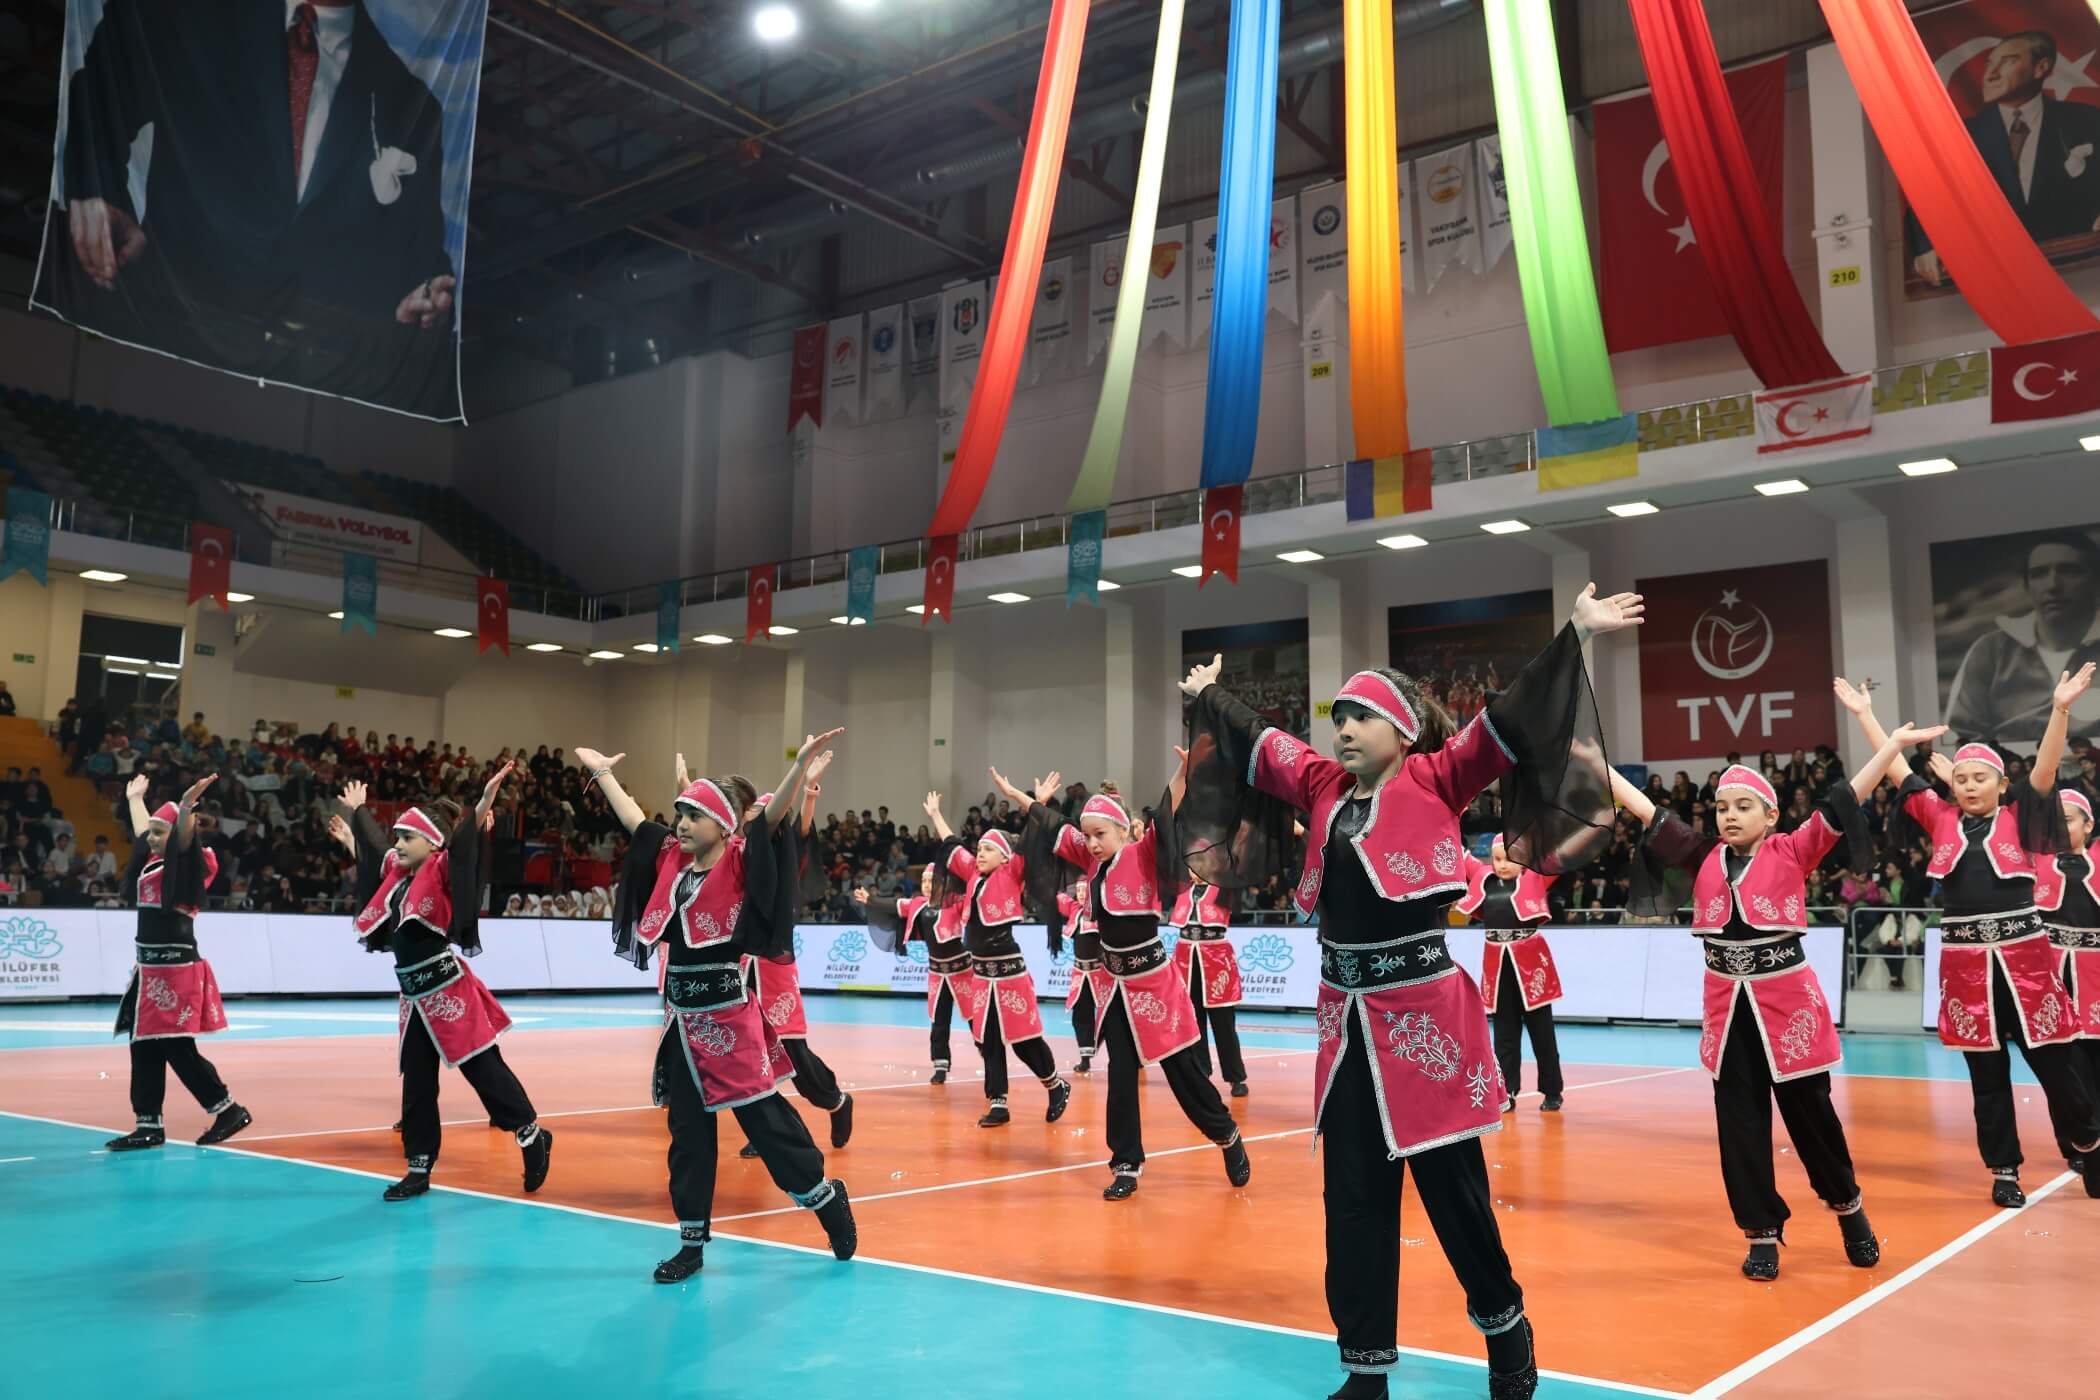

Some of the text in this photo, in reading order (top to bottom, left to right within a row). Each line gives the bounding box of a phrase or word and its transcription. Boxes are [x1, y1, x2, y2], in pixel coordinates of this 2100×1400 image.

[1831, 270, 1856, 284] 210
[1677, 691, 1795, 742] TVF
[0, 961, 61, 972] İLÜFER
[0, 974, 60, 983] ELEDİYESİ
